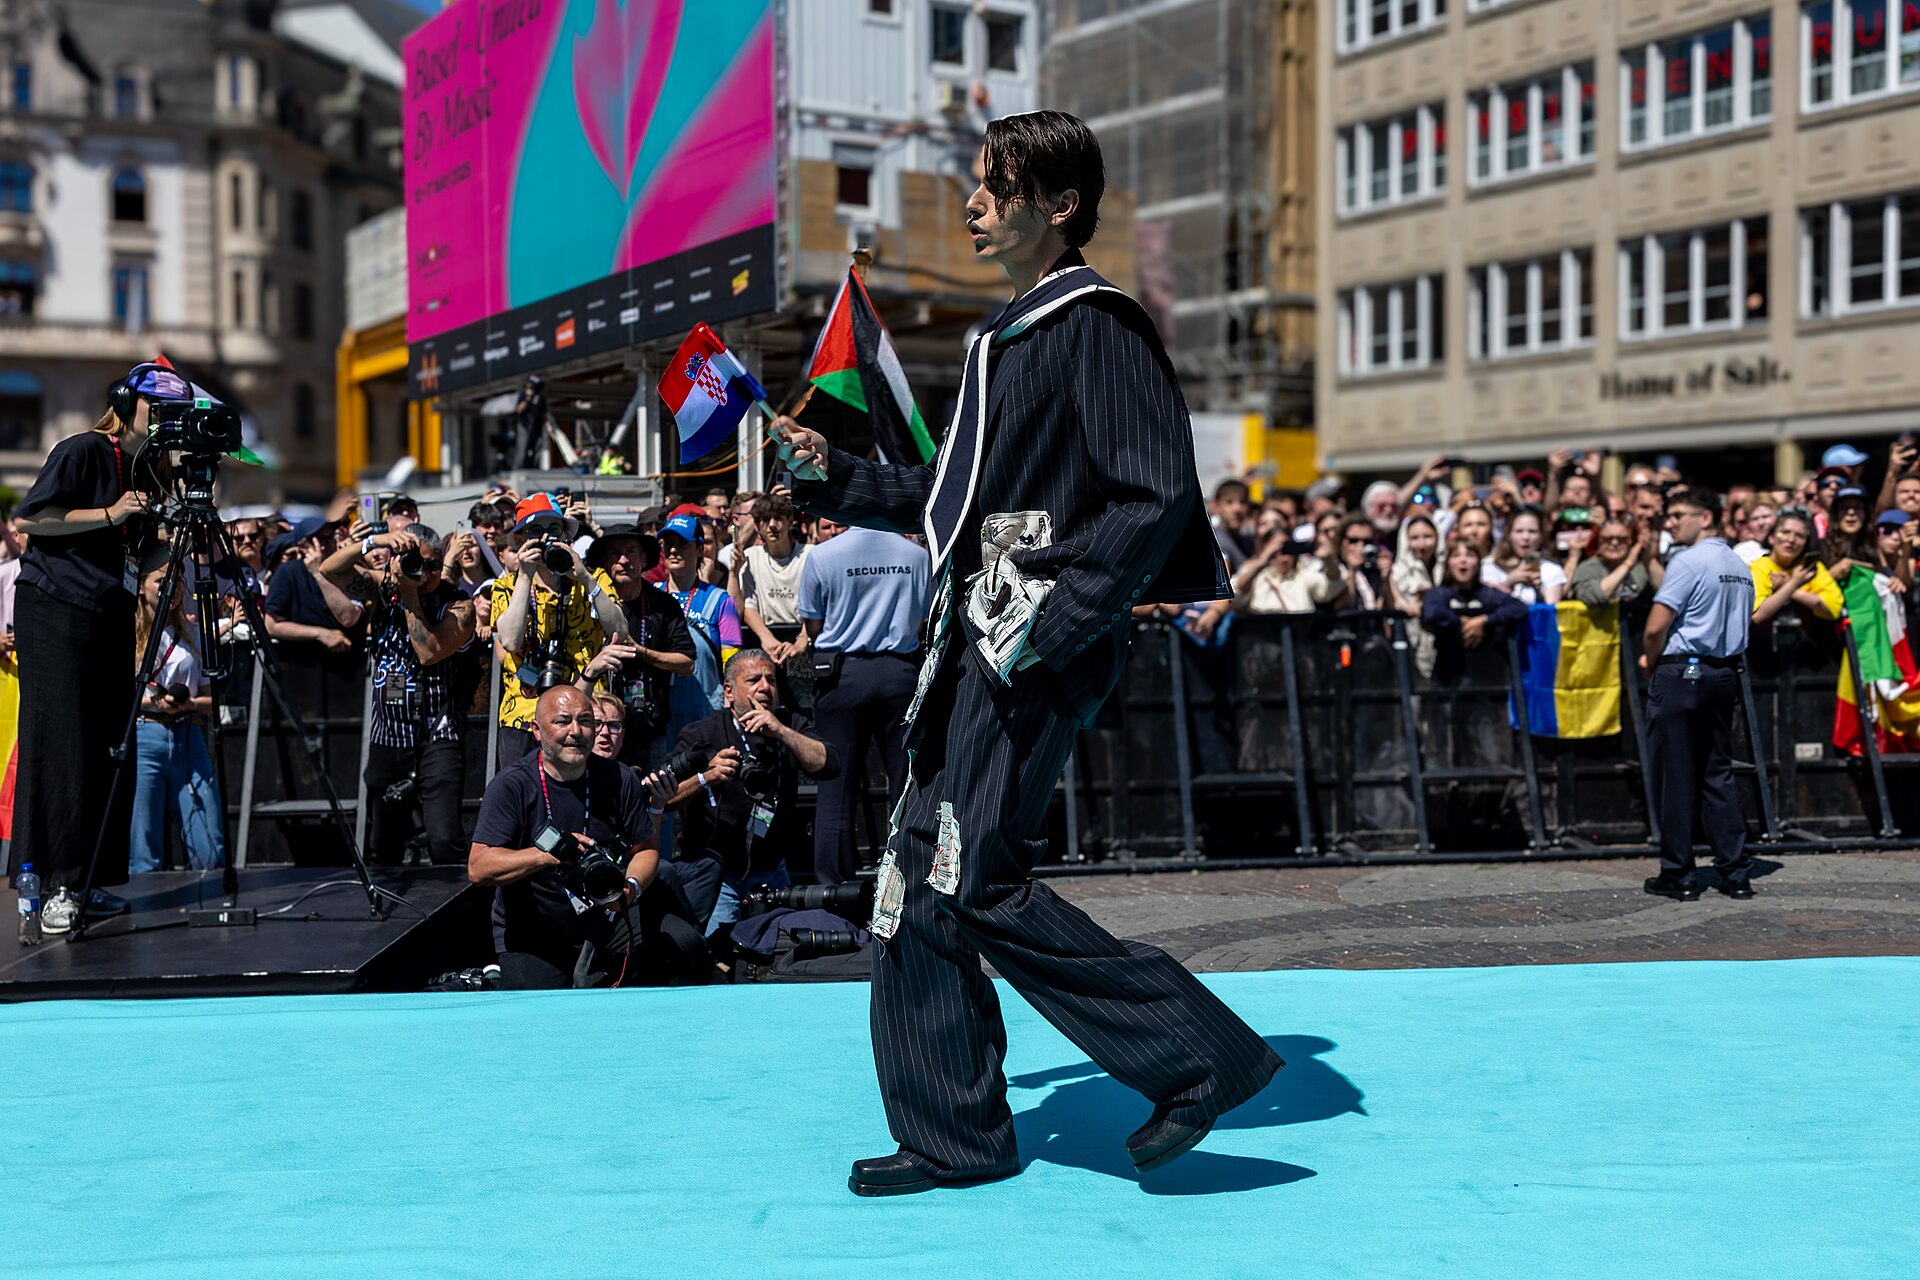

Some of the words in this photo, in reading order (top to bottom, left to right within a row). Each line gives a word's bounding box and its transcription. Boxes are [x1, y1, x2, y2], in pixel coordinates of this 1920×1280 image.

[412, 18, 462, 100] Basel
[414, 110, 444, 169] By
[444, 68, 498, 141] Music
[1600, 368, 1677, 399] Home
[1685, 361, 1714, 391] of
[1723, 355, 1793, 391] Salt.
[846, 566, 912, 577] SECURITAS
